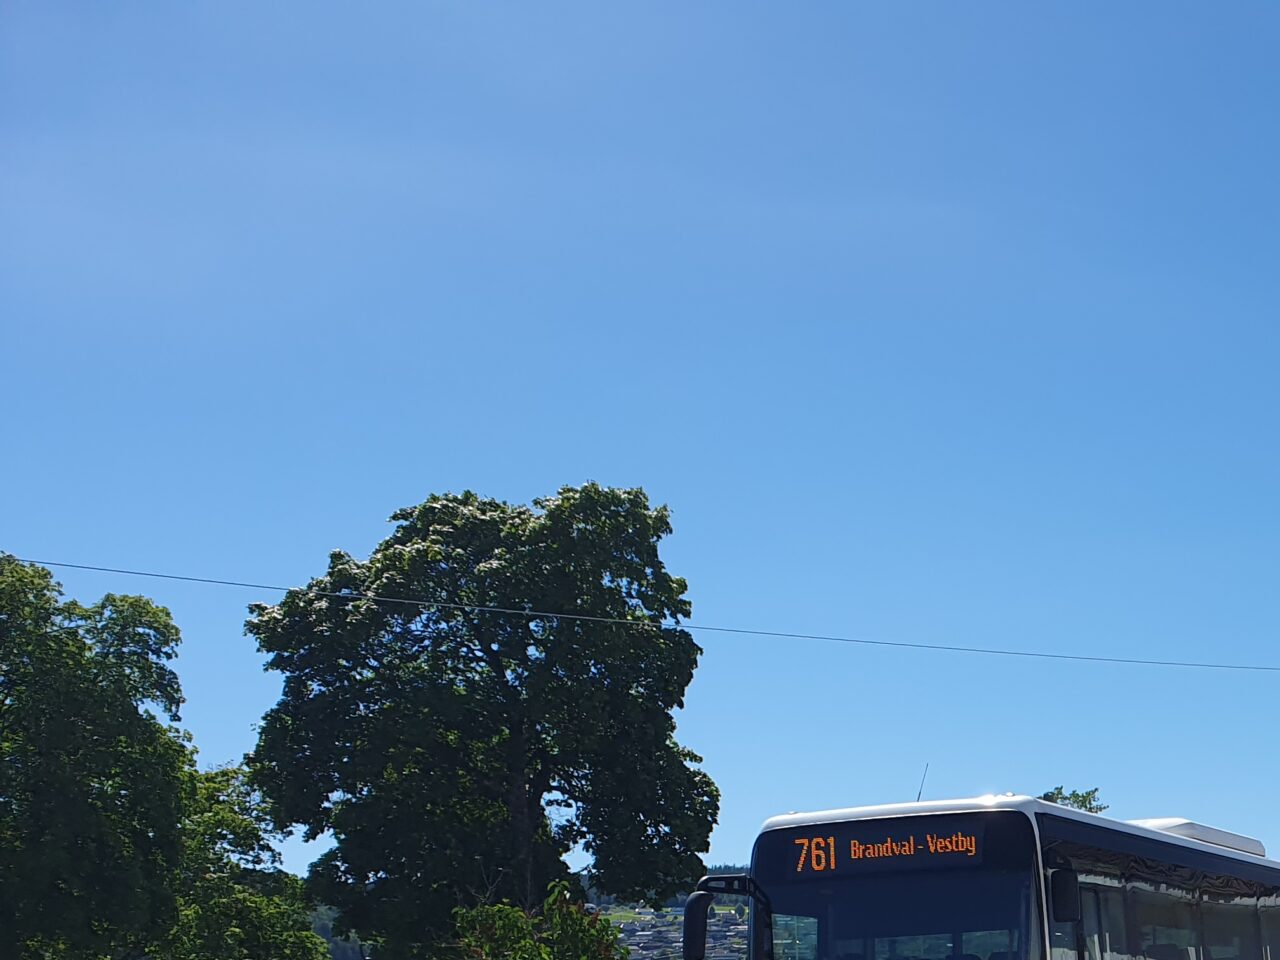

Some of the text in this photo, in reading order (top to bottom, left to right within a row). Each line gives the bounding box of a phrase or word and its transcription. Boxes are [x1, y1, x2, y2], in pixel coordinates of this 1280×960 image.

[794, 836, 836, 872] 761
[850, 835, 915, 859] Brandval
[926, 832, 976, 856] Vestby
